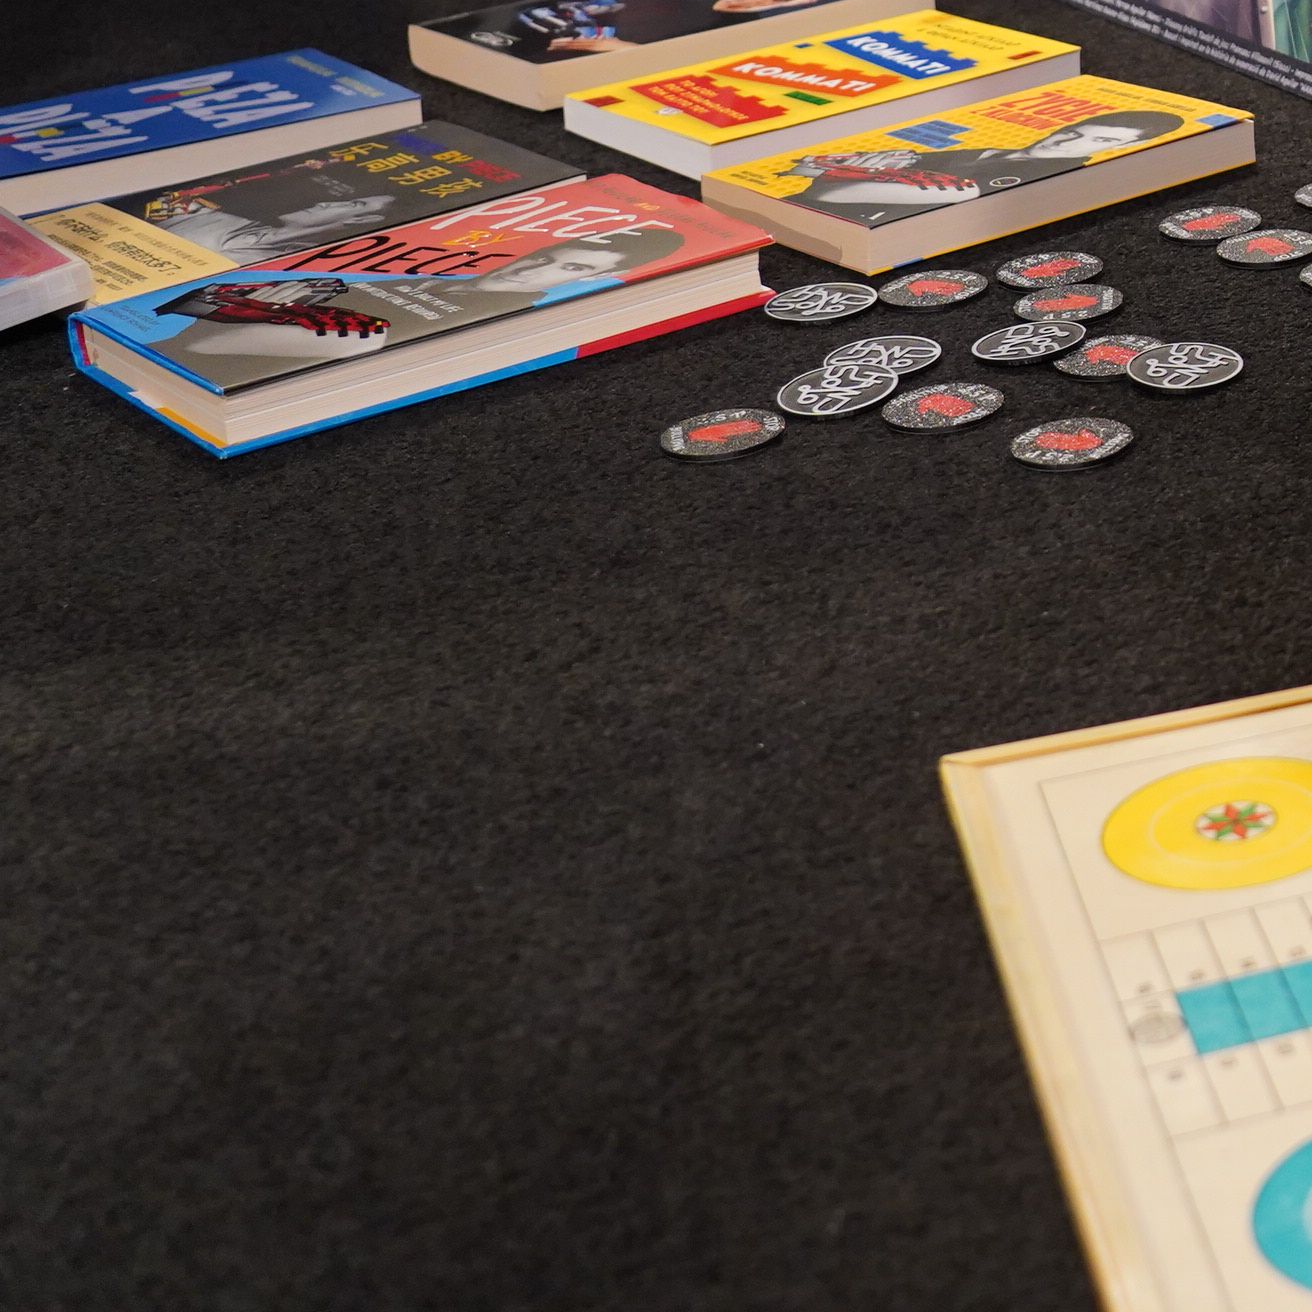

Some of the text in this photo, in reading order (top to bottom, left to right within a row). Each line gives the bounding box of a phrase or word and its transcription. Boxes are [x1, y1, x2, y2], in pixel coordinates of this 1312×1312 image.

[329, 141, 485, 199] 乐高男孩
[432, 150, 474, 165] BY
[430, 195, 675, 245] PIECE
[443, 229, 523, 250] BY
[284, 235, 517, 278] PIECE
